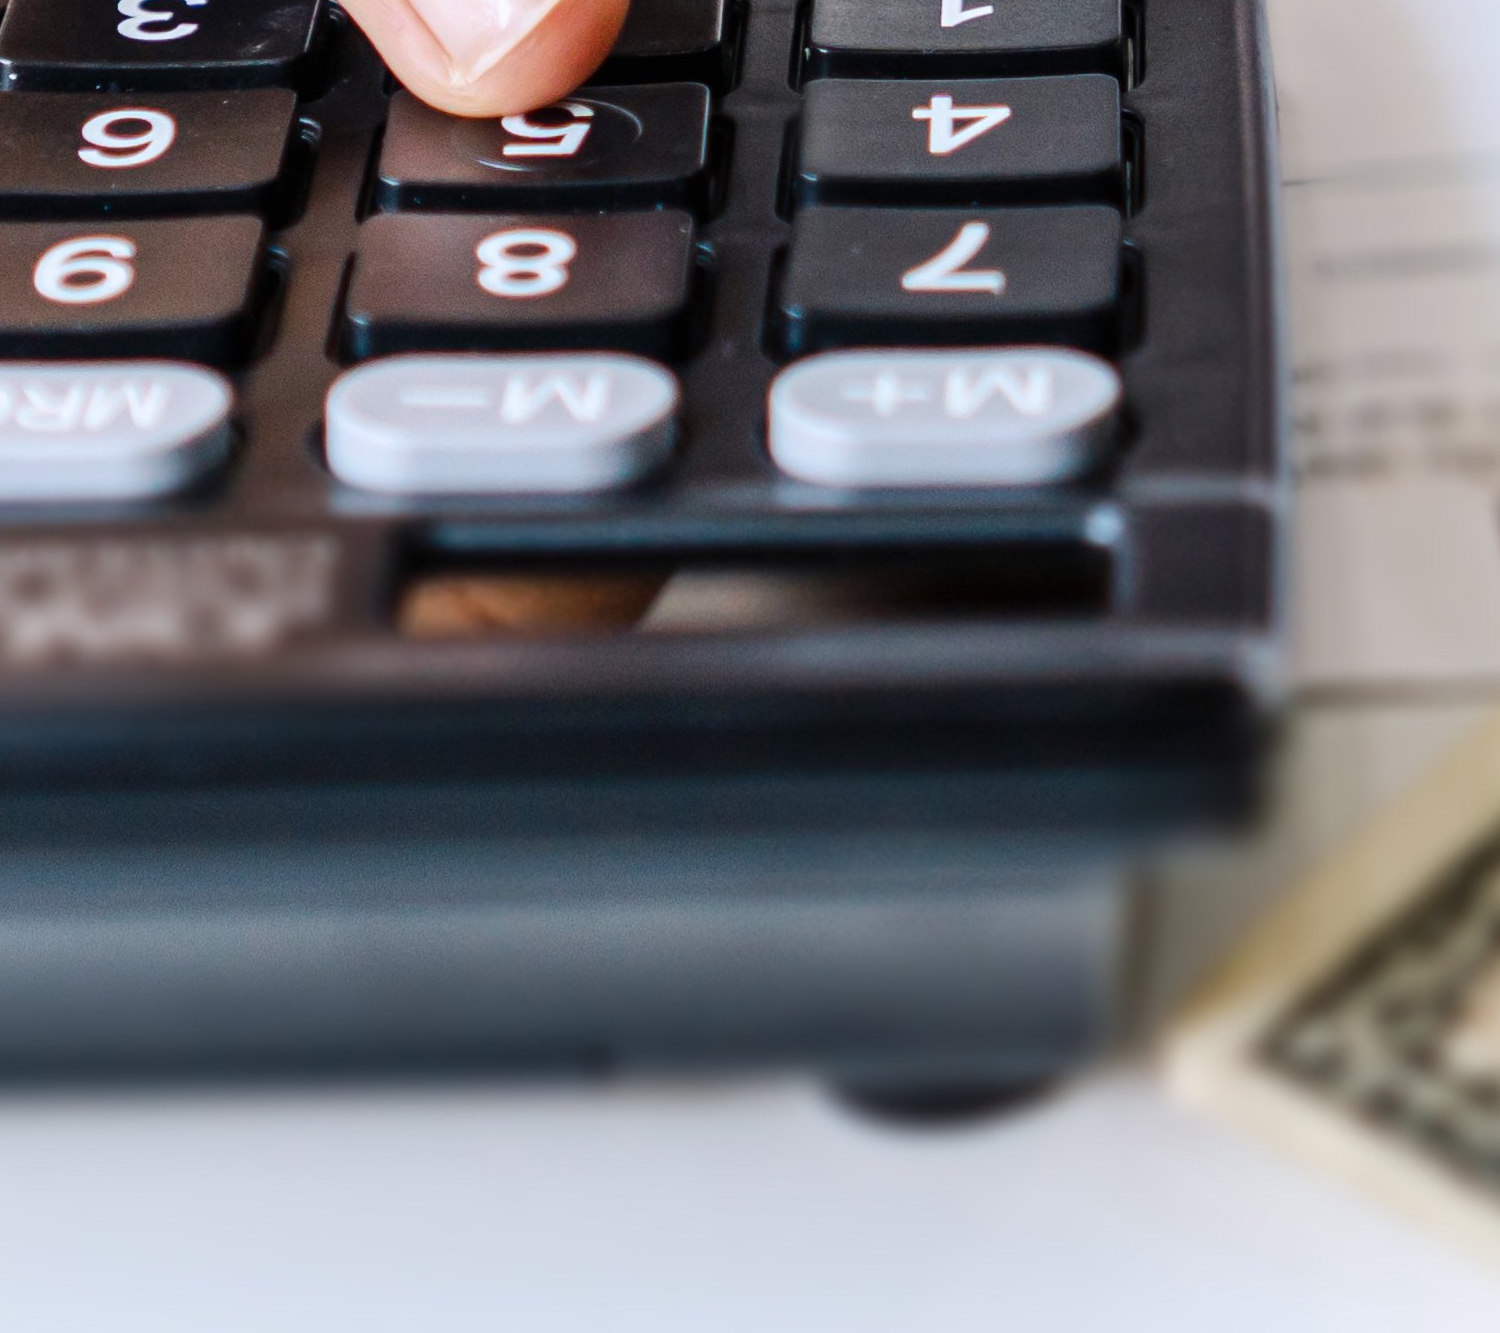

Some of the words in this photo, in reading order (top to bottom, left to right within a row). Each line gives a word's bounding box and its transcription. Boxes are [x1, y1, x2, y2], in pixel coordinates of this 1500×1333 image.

[77, 108, 176, 168] 6
[502, 100, 595, 155] 5
[913, 95, 1009, 153] 4
[34, 236, 137, 302] 9
[477, 230, 576, 295] 8
[902, 223, 1005, 294] 7
[843, 362, 1051, 417] M+
